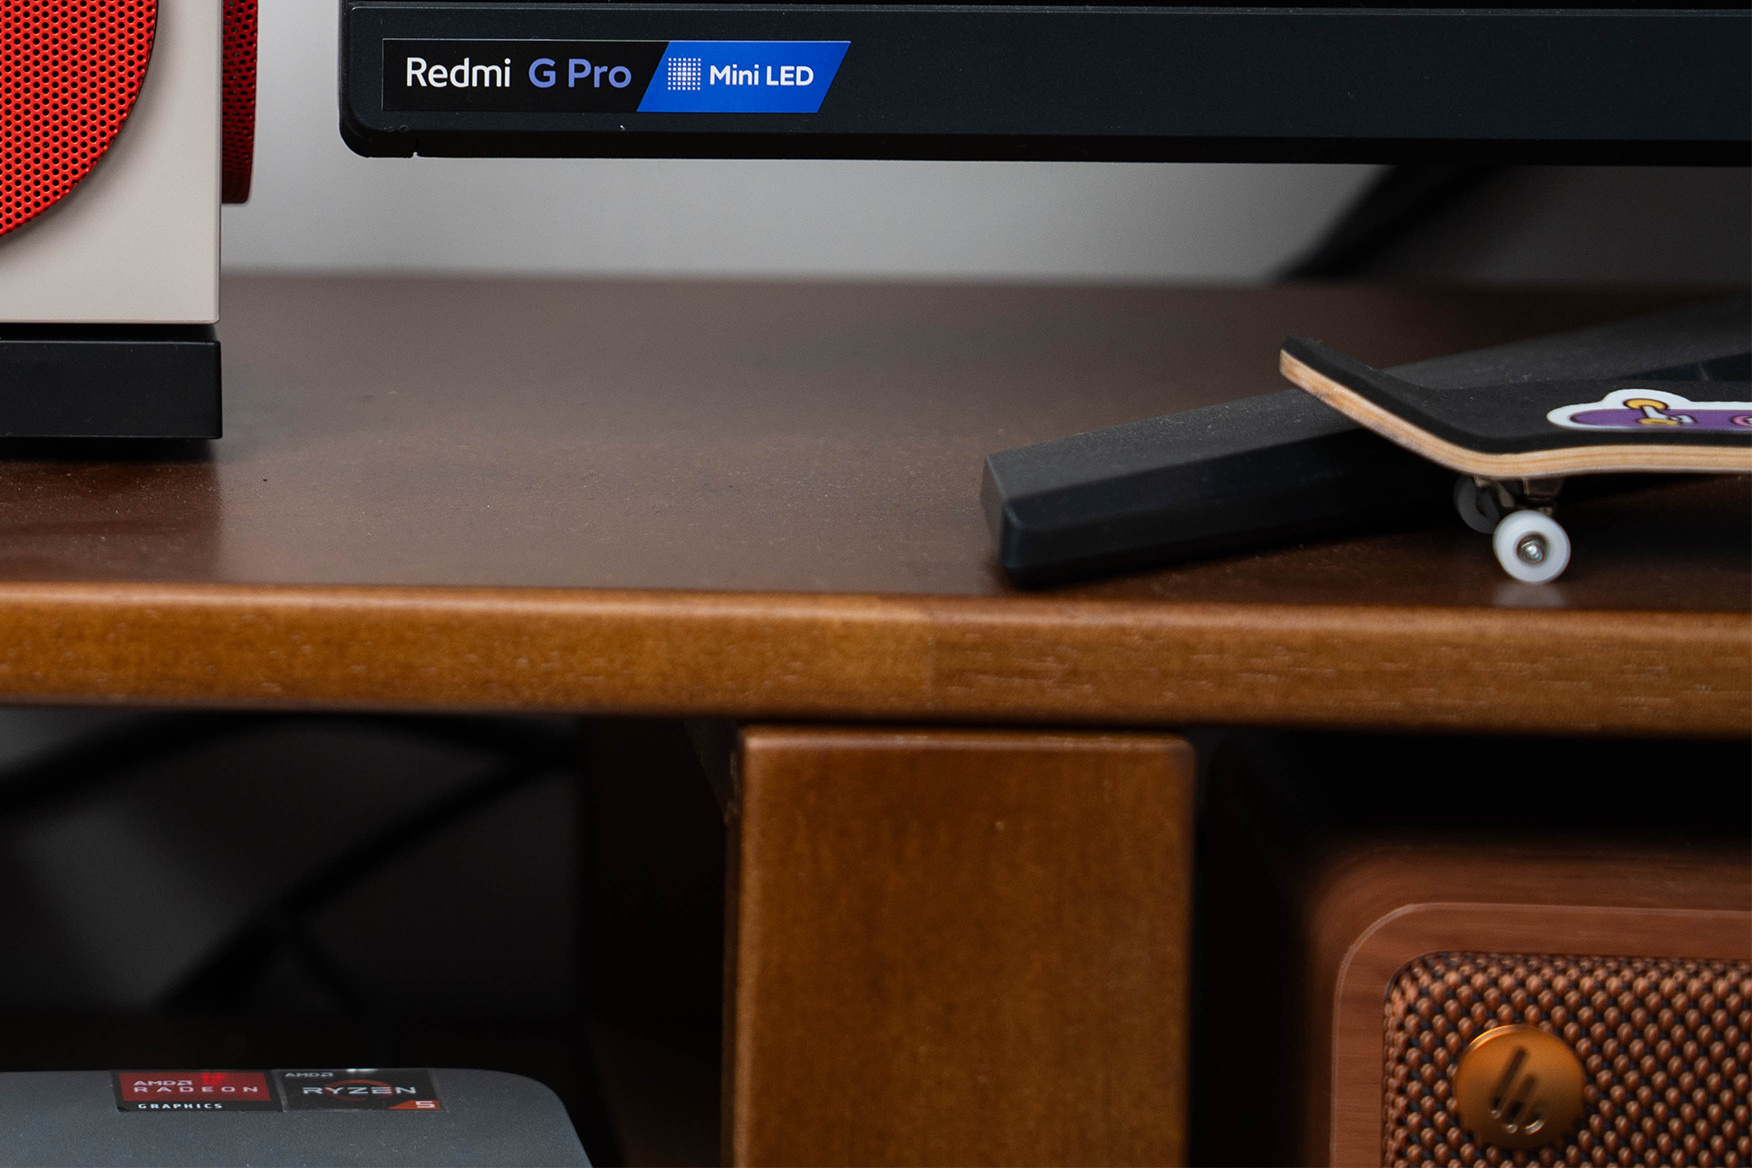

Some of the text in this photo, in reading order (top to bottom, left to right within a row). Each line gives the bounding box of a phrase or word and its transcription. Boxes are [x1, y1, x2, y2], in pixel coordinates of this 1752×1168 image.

[405, 57, 633, 89] Redmi G Pro
[709, 64, 815, 87] Mini LED
[302, 1086, 417, 1094] RYZEN
[415, 1100, 436, 1108] 5
